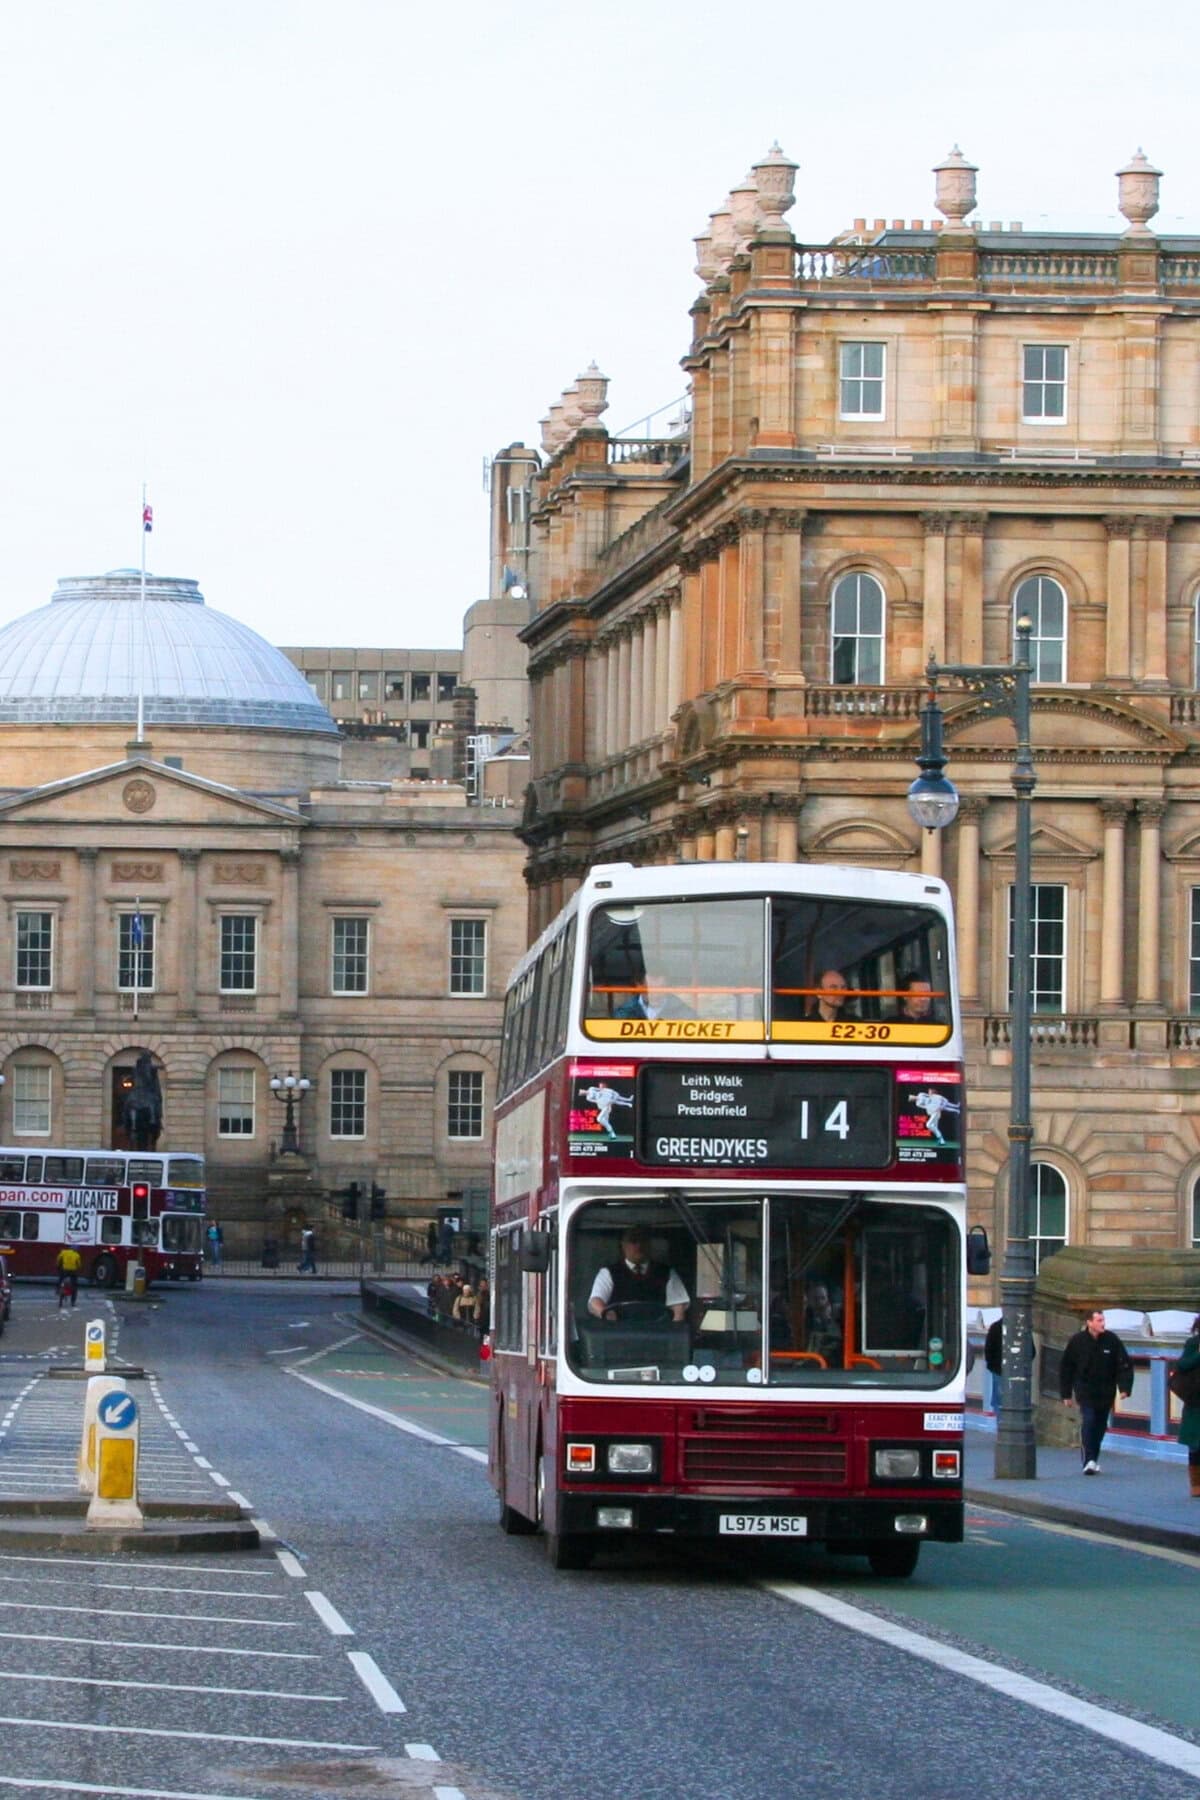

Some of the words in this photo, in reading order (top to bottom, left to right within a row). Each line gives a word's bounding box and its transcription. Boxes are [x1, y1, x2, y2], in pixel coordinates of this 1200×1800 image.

[620, 1022, 660, 1037] DAY
[665, 1023, 736, 1038] TICKET
[681, 1075, 711, 1087] Leith
[714, 1075, 743, 1088] Walk
[690, 1090, 735, 1102] Bridges
[677, 1104, 747, 1117] Prestonfield
[656, 1137, 768, 1158] GREENDYKES
[67, 1190, 117, 1210] ALICANTE
[726, 1517, 766, 1532] L975
[770, 1518, 800, 1532] MSC
